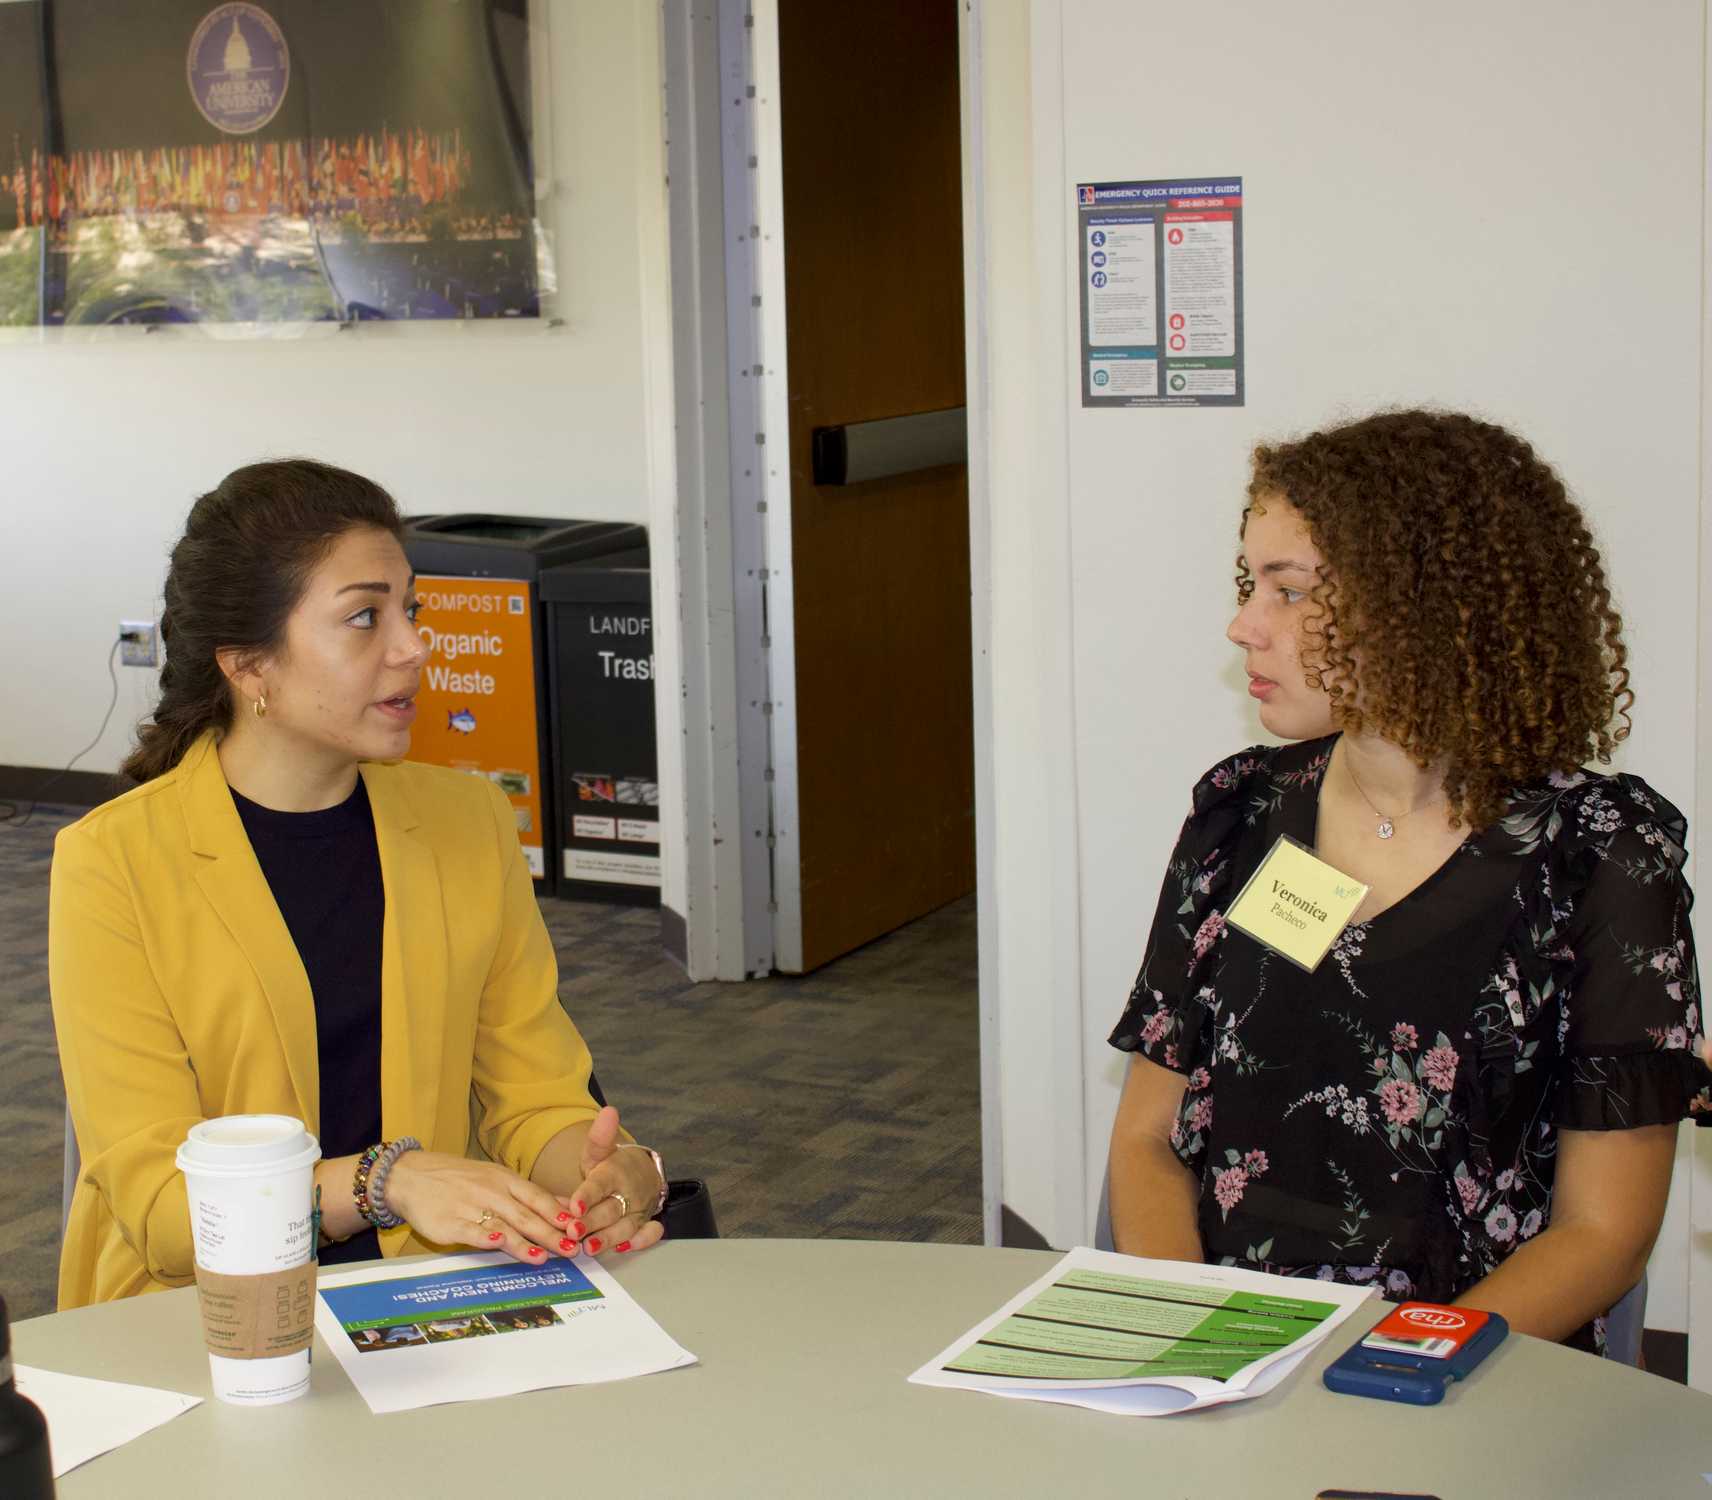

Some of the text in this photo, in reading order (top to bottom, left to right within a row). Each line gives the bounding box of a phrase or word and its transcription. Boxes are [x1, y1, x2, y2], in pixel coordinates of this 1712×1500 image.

[1095, 185, 1240, 199] EMERGENCY QUICK REFERENCE GUIDE
[415, 591, 503, 613] COMPOST
[427, 666, 496, 695] Waste
[1271, 879, 1328, 922] Veronica
[1270, 902, 1307, 930] Pacheco
[477, 1271, 567, 1289] RETURNING
[494, 1277, 572, 1294] WELCOME
[392, 1283, 474, 1302] COACHES!
[415, 1293, 449, 1303] AND
[453, 1288, 489, 1299] NEW
[1409, 1312, 1455, 1325] rha
